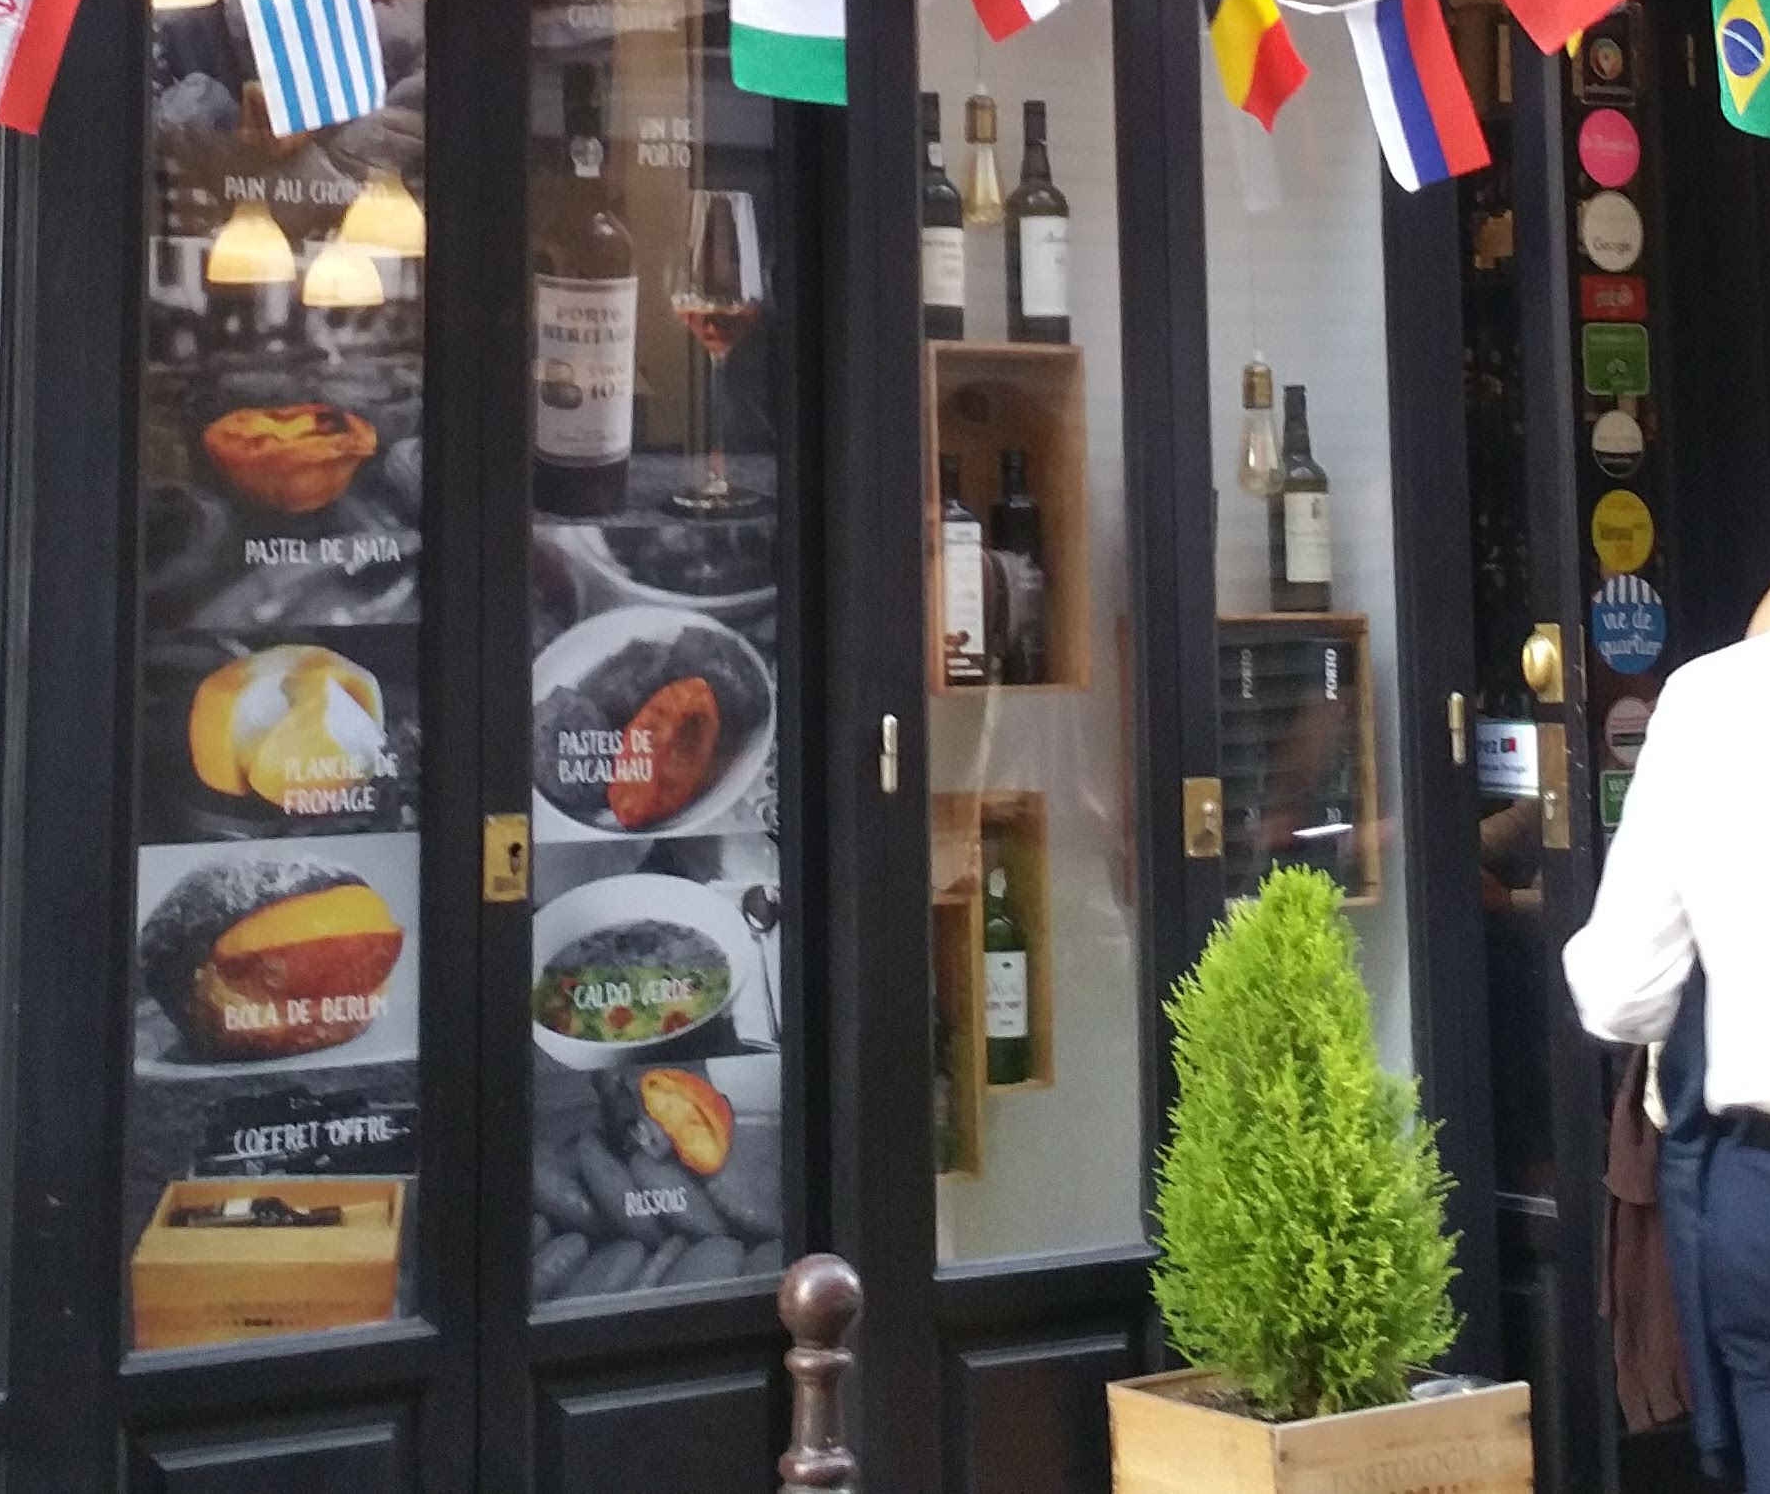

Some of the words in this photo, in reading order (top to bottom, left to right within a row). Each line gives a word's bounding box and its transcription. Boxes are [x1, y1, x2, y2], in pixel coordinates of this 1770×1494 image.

[637, 142, 692, 168] PORTO
[224, 175, 266, 201] PAIN
[274, 177, 304, 204] AU
[245, 536, 311, 566] PASTEL
[319, 536, 345, 564] DE
[352, 535, 402, 564] NATA
[1324, 647, 1338, 700] PORTO
[630, 728, 654, 754] DE
[284, 755, 367, 782] PLANCHE
[374, 750, 399, 779] DE
[558, 757, 653, 784] BACALHAU
[283, 784, 377, 815] FROMAGE
[573, 981, 632, 1010] CALDO
[638, 977, 693, 1007] VERDE
[224, 1001, 281, 1031] BOLA
[287, 997, 312, 1027] DE
[233, 1120, 320, 1156] COFFRET
